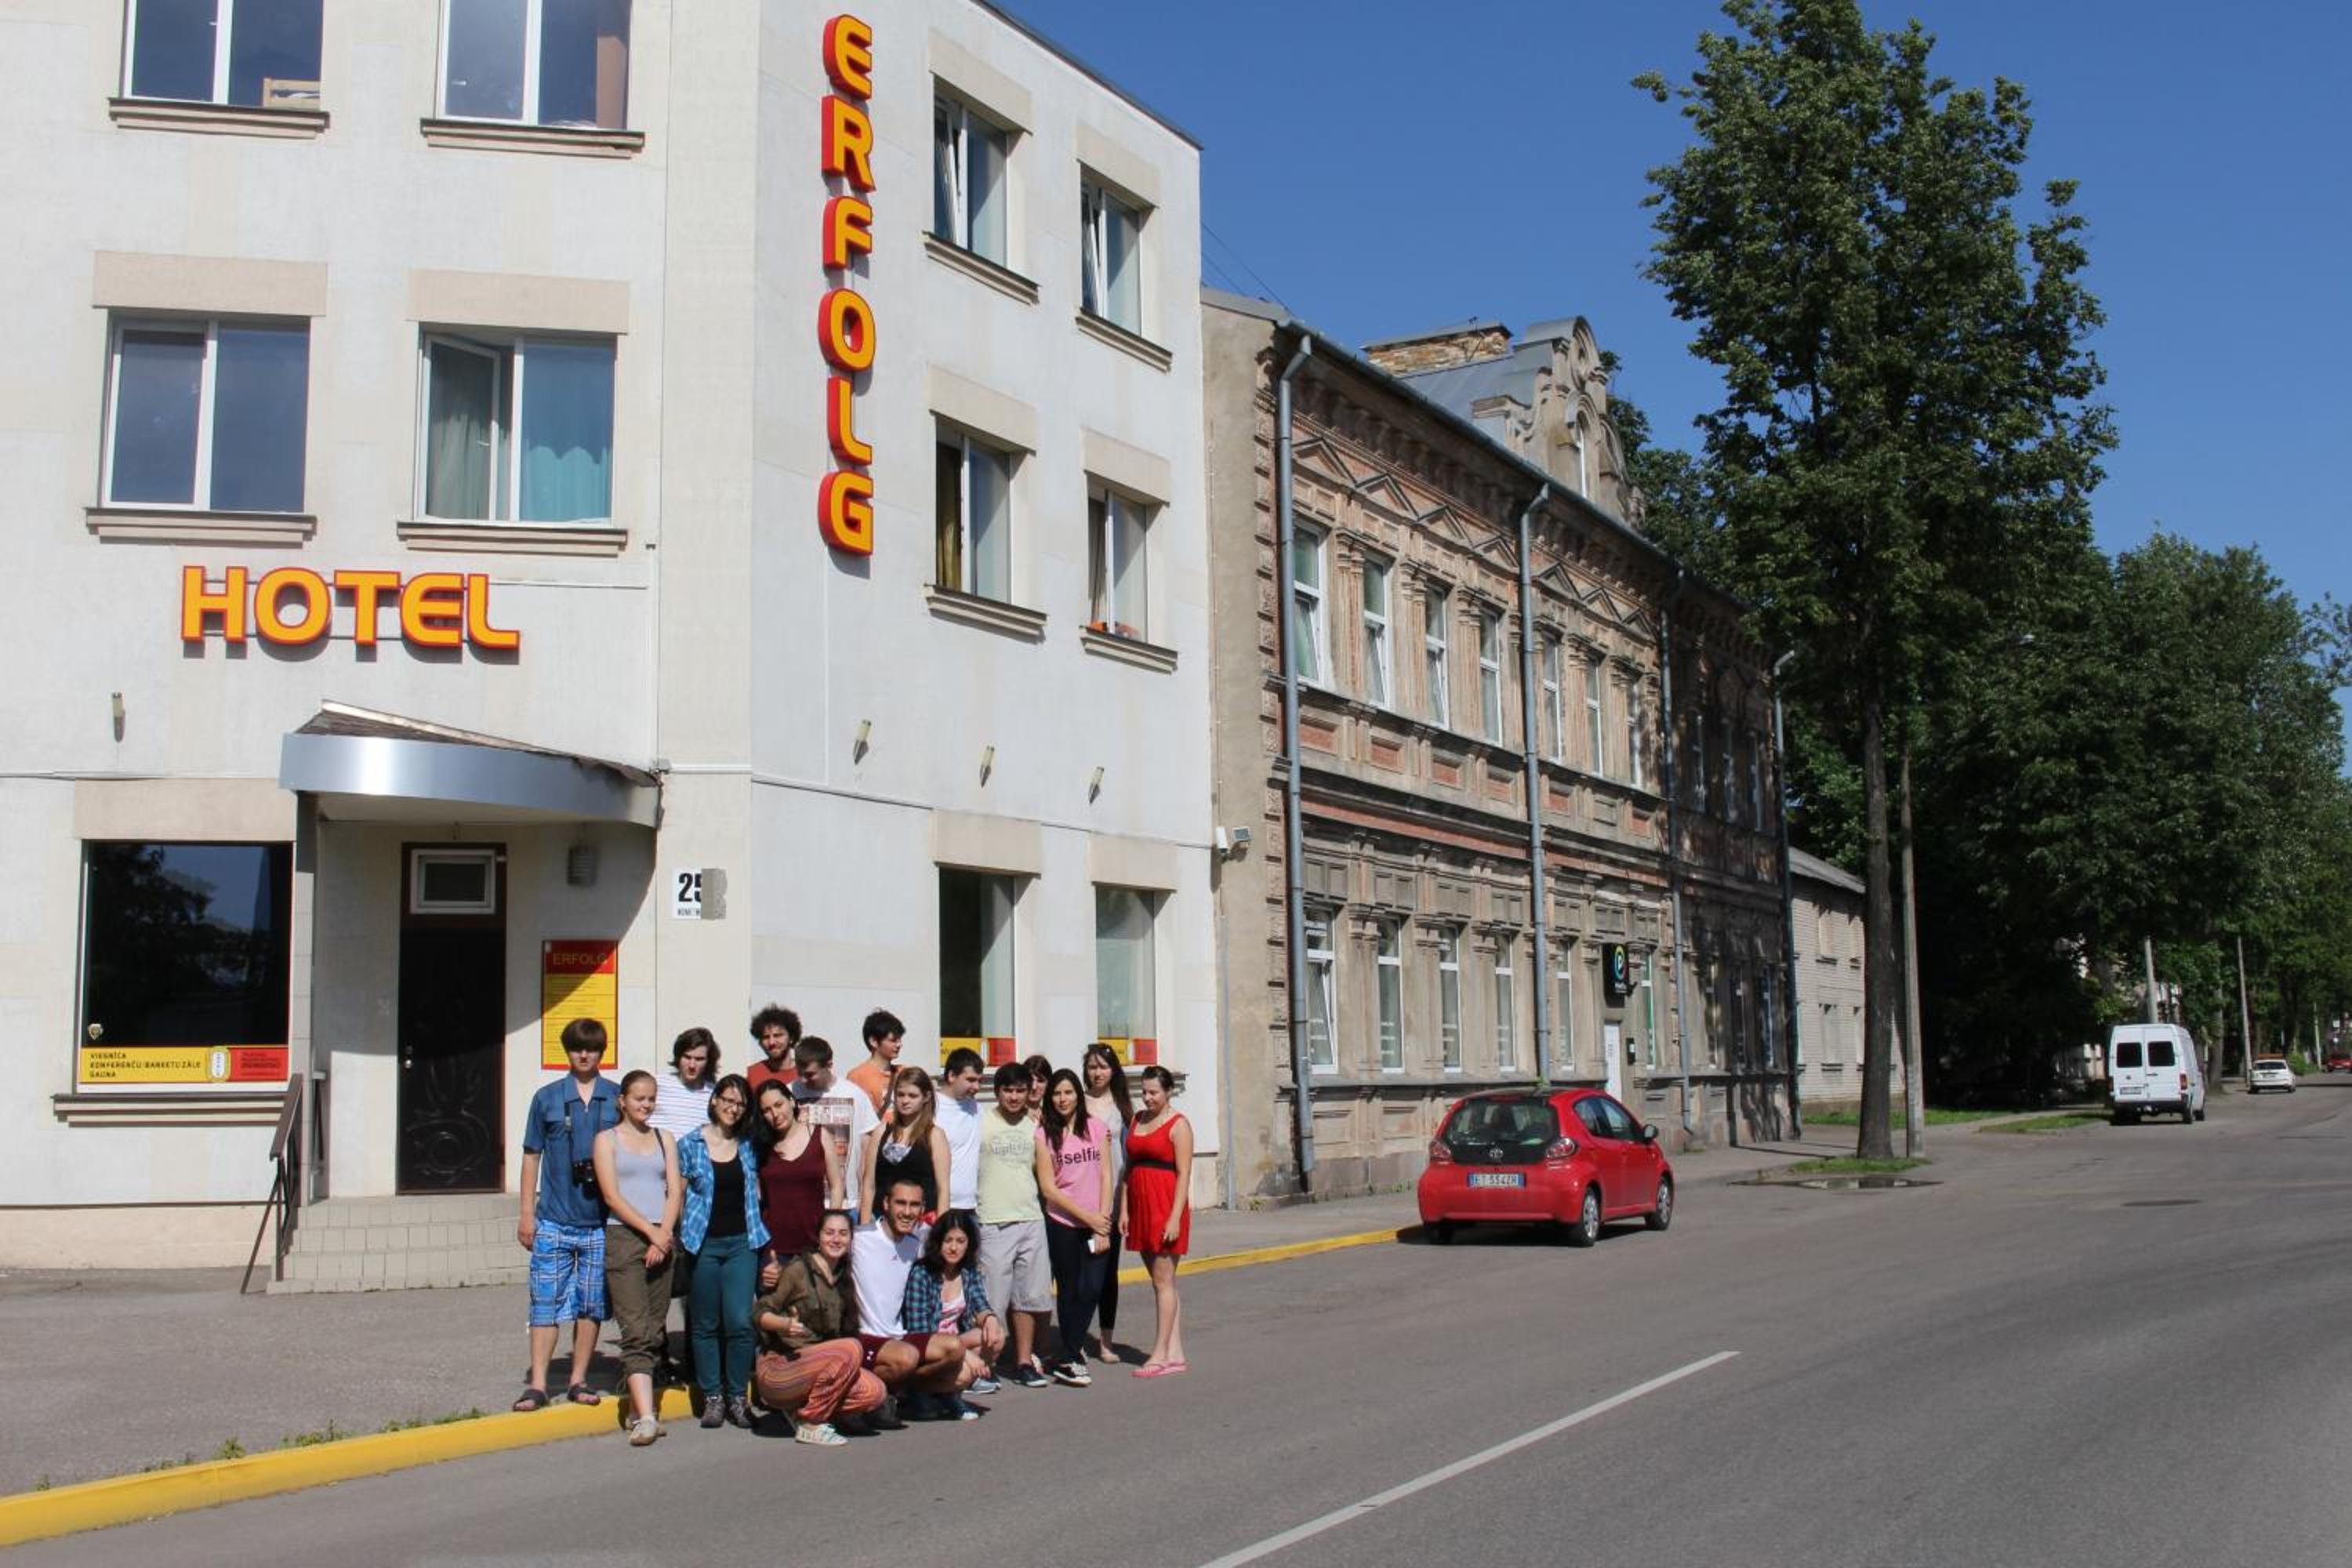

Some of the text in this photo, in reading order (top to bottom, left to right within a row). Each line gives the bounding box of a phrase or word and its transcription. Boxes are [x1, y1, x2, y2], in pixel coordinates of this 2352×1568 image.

[818, 14, 877, 556] ERFOLG
[181, 565, 521, 649] HOTEL
[552, 953, 609, 965] ERFOLG
